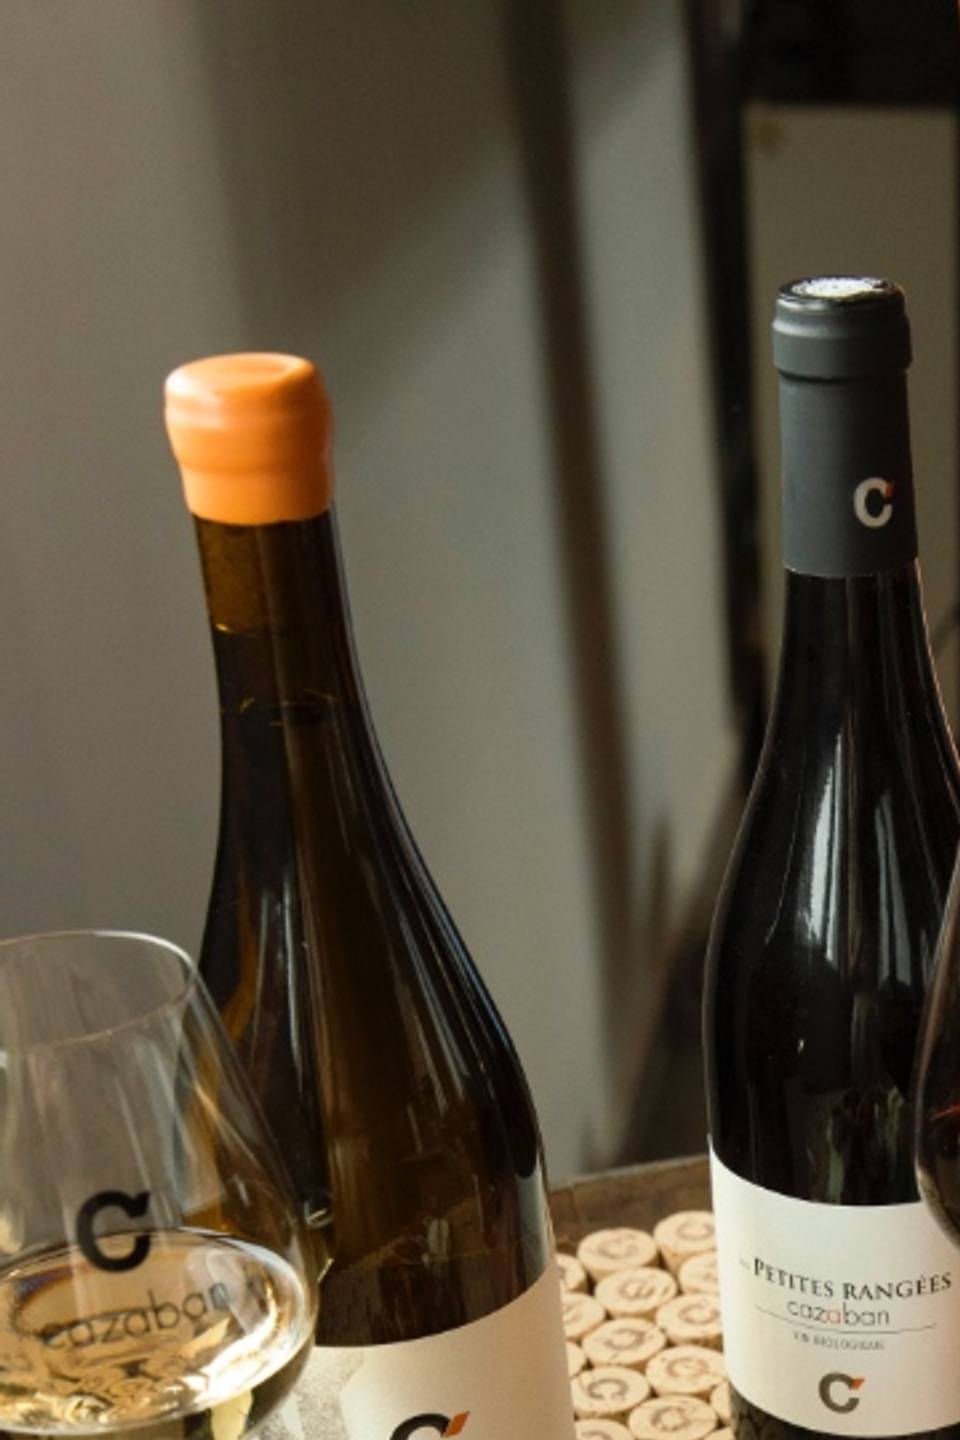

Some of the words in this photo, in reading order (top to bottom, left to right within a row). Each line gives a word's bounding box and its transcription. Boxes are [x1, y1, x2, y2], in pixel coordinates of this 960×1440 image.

[754, 1258, 834, 1298] PETITES
[842, 1271, 952, 1300] RANGÉES
[787, 1301, 890, 1326] cazaban
